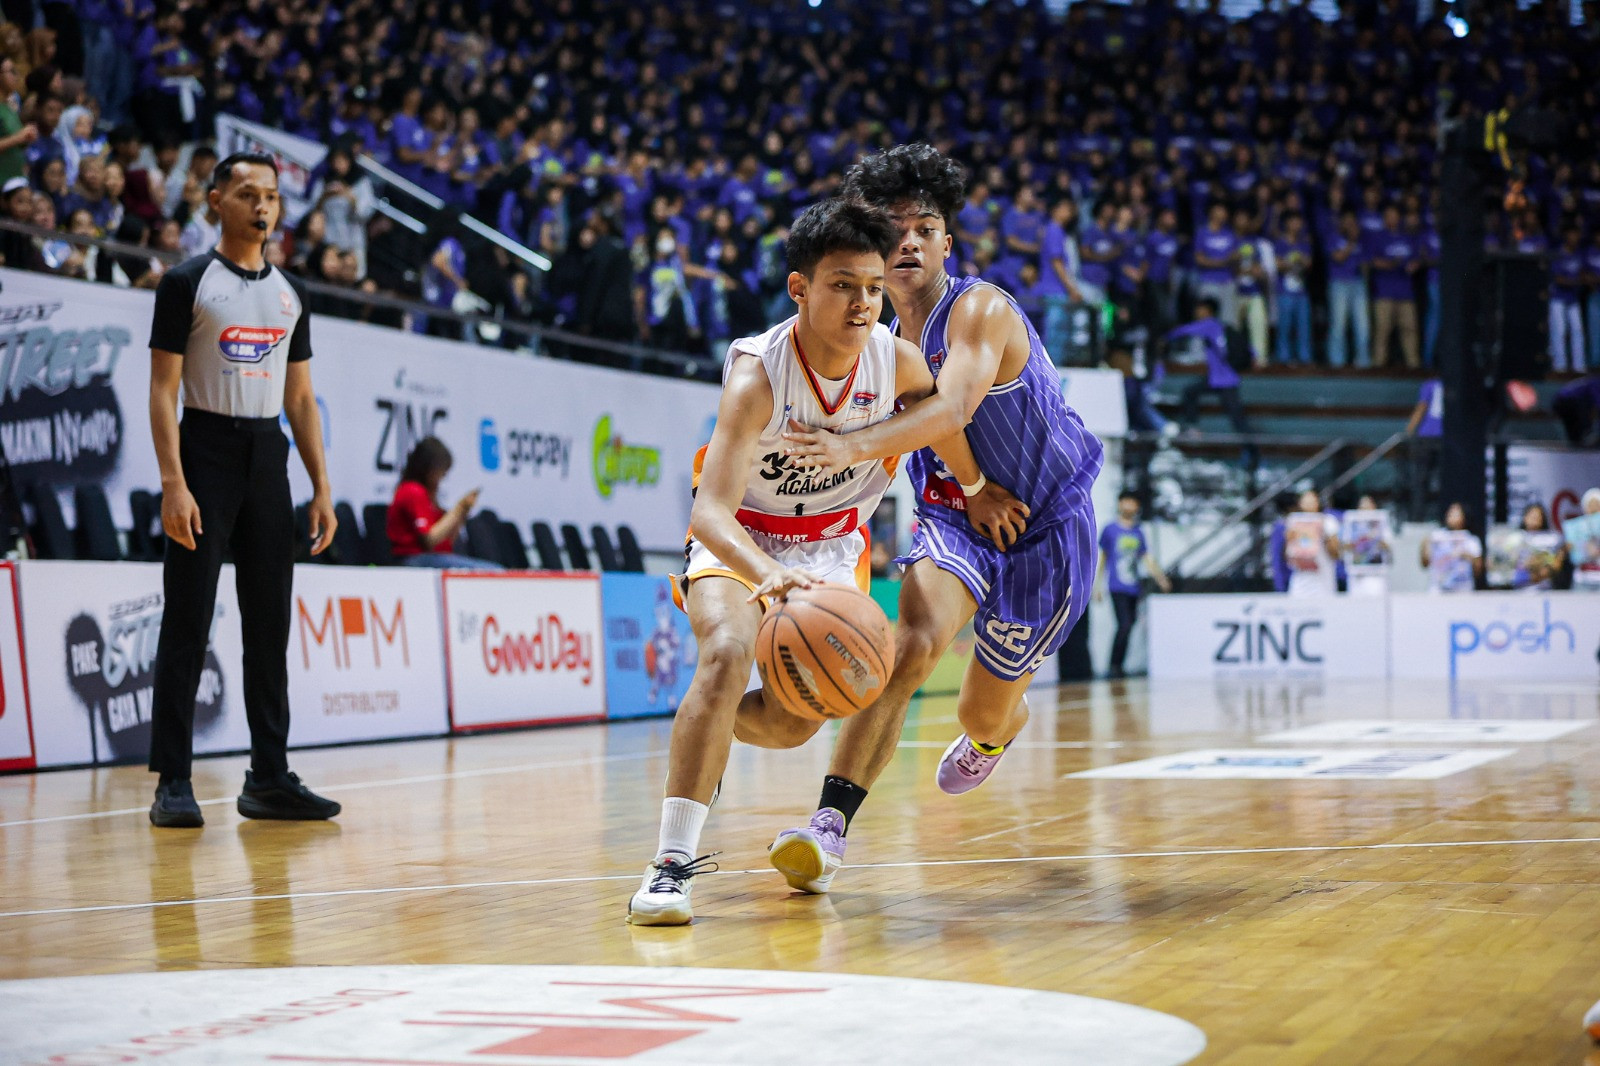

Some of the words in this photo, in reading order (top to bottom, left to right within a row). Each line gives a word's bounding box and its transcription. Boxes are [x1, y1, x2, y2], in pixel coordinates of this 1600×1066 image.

[775, 466, 857, 496] ACADEMY
[297, 596, 411, 671] MPM
[1214, 604, 1323, 663] ZINC
[1450, 597, 1576, 678] posh
